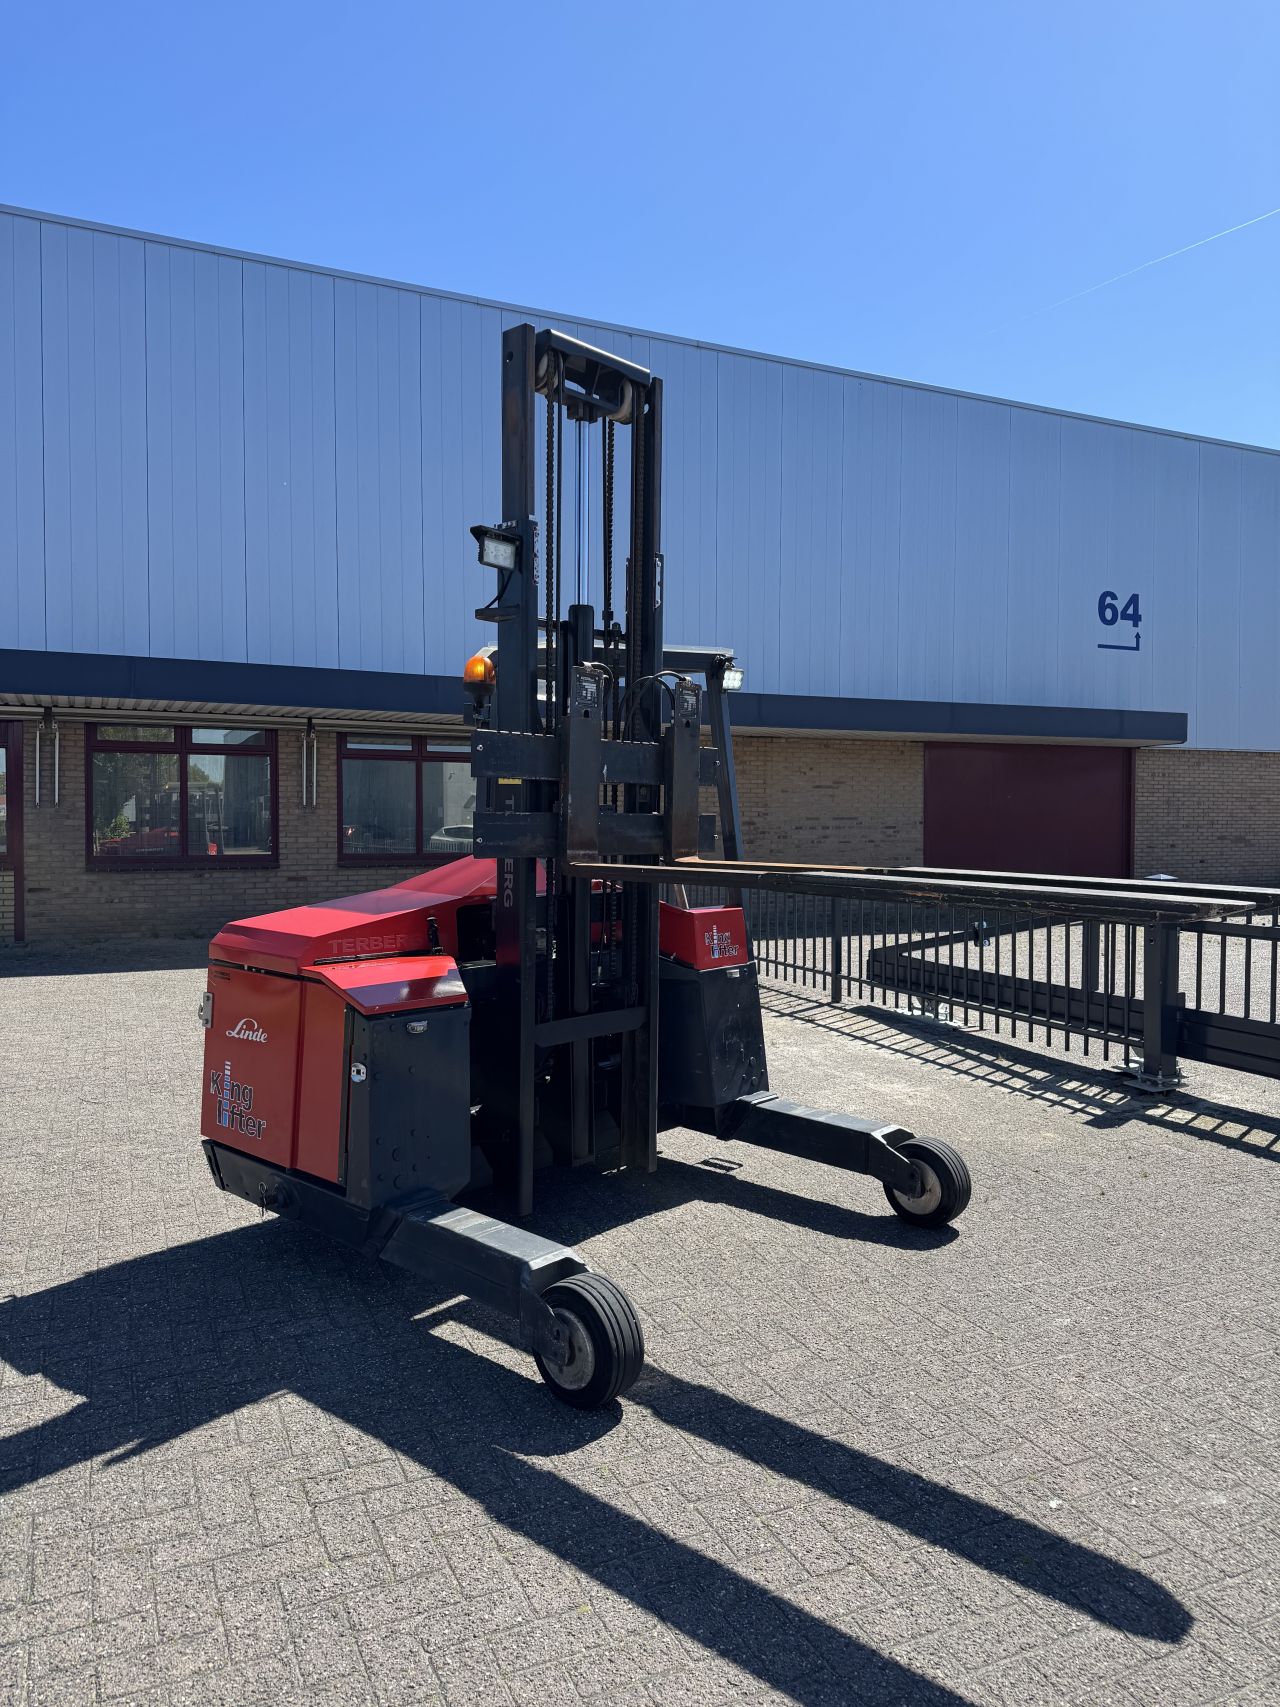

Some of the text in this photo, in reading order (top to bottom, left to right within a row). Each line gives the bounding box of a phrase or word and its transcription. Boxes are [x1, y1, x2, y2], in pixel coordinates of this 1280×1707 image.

[1098, 590, 1142, 628] 64
[328, 934, 425, 954] TERBER
[225, 1017, 268, 1043] Linde
[210, 1060, 254, 1113] King
